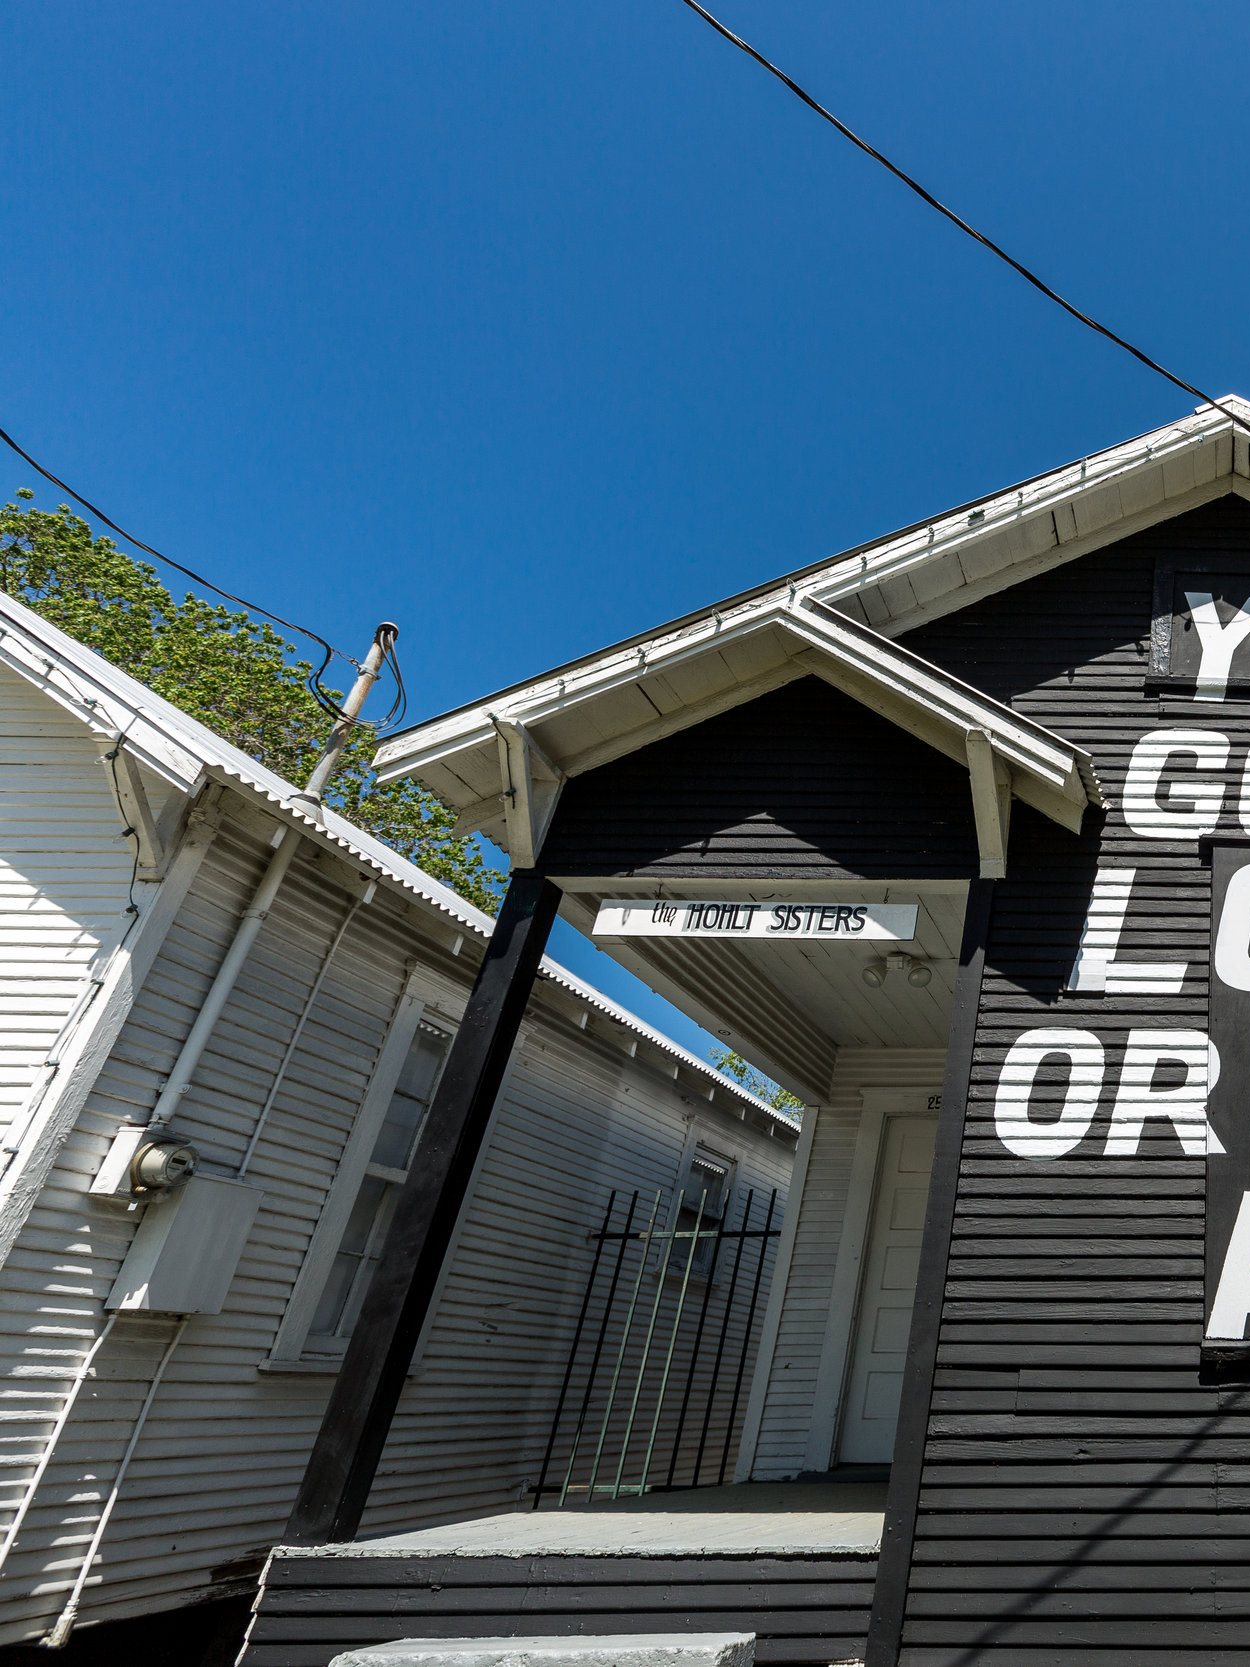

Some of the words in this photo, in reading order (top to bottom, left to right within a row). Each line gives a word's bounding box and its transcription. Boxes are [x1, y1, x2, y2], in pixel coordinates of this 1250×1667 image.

[651, 902, 677, 925] the
[686, 903, 761, 931] HOHLT
[770, 904, 868, 931] SISTERS
[993, 1027, 1227, 1161] OR
